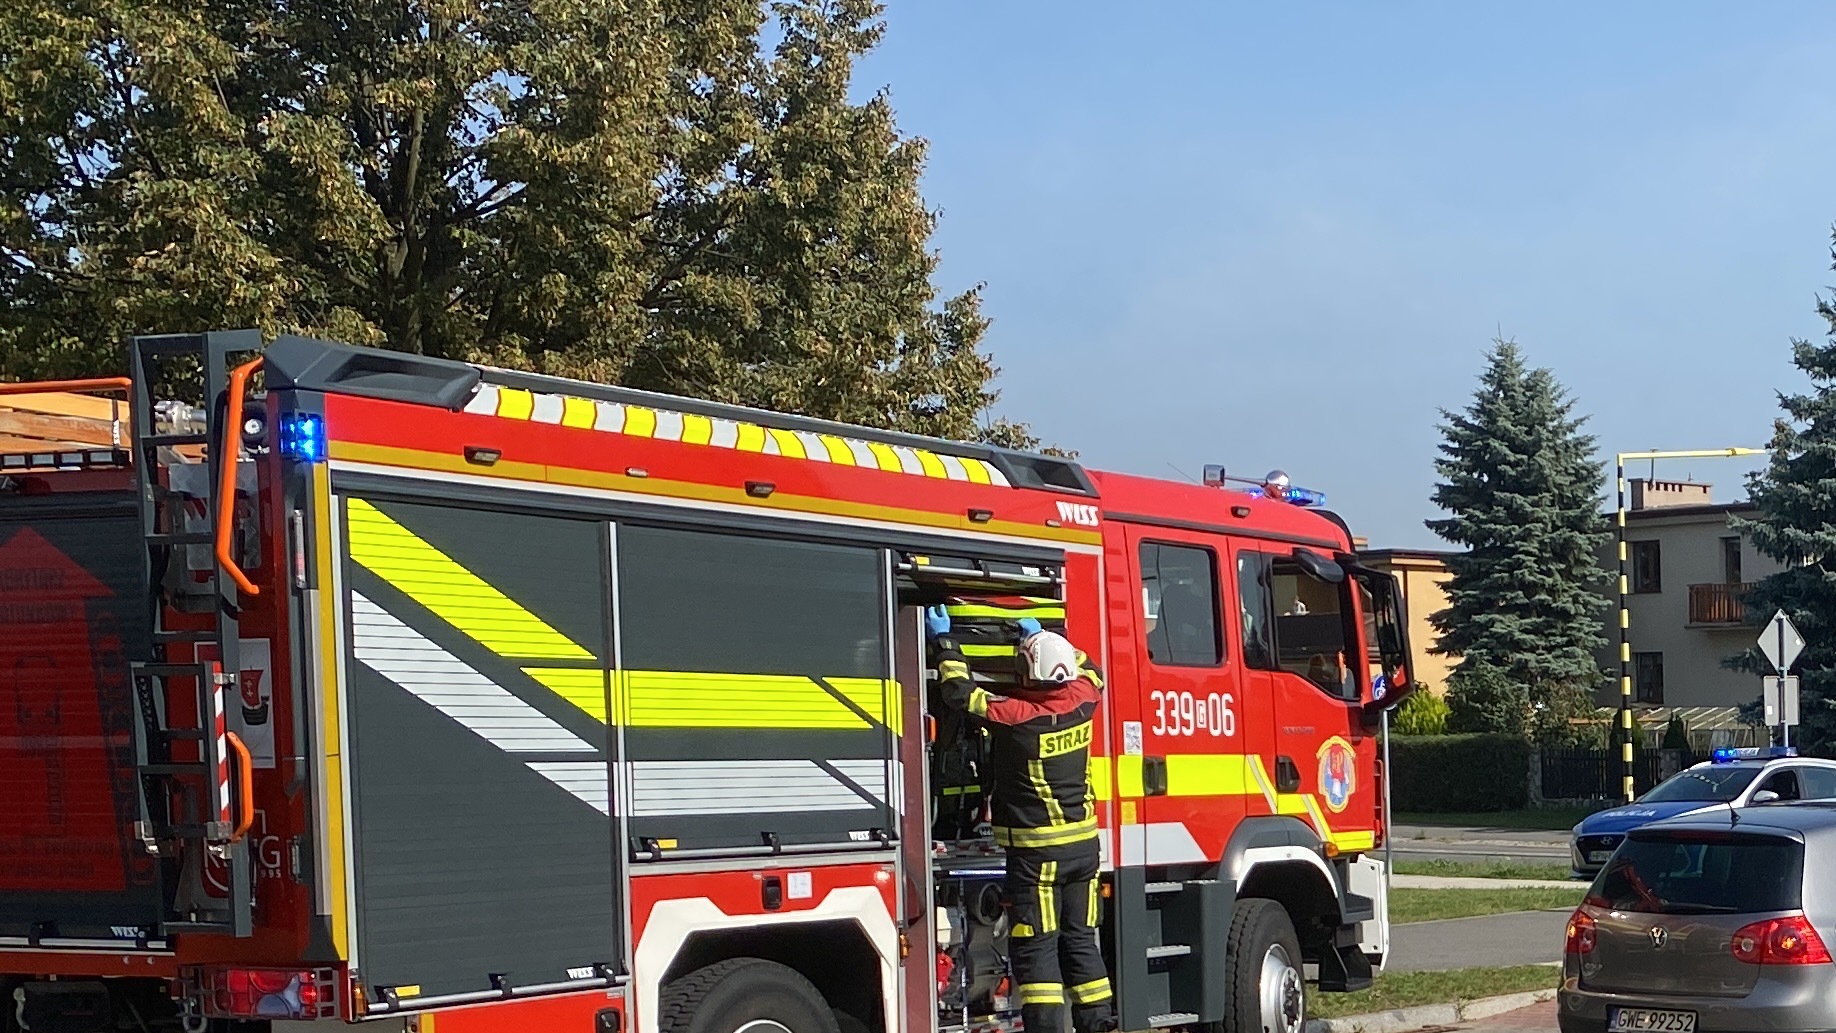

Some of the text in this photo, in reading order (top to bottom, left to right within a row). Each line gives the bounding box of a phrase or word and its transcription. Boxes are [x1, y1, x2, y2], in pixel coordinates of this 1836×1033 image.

[1055, 500, 1099, 527] WISS
[1617, 1009, 1695, 1033] GWE 99252
